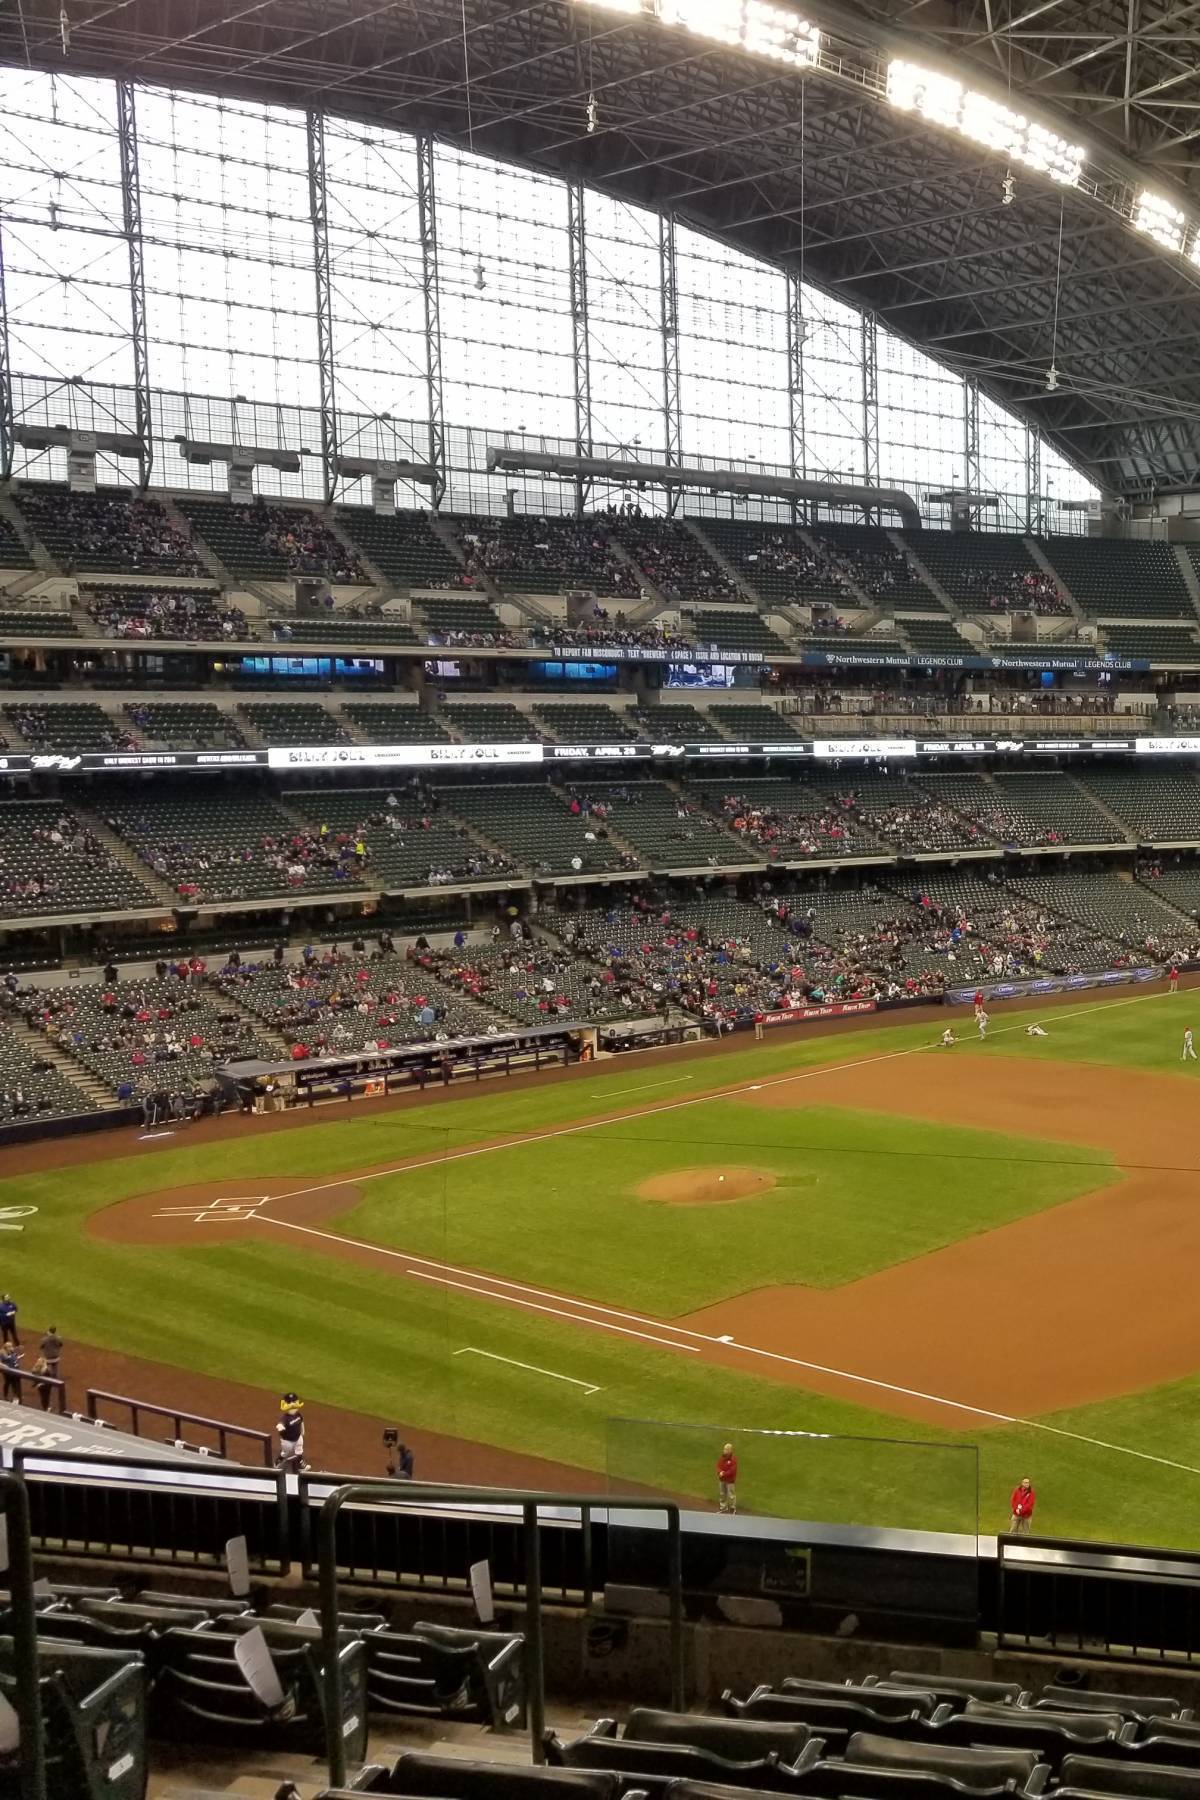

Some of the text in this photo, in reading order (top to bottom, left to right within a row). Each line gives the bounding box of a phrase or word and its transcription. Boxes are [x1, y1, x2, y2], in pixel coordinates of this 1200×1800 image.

[835, 655, 885, 664] Northwestern
[918, 658, 946, 666] LEGENDS
[947, 658, 963, 666] CLUB
[1001, 659, 1051, 668] Northwestern
[1084, 661, 1113, 669] LEGENDS
[1115, 661, 1132, 669] CLUB
[554, 747, 589, 757] FRIDAY,
